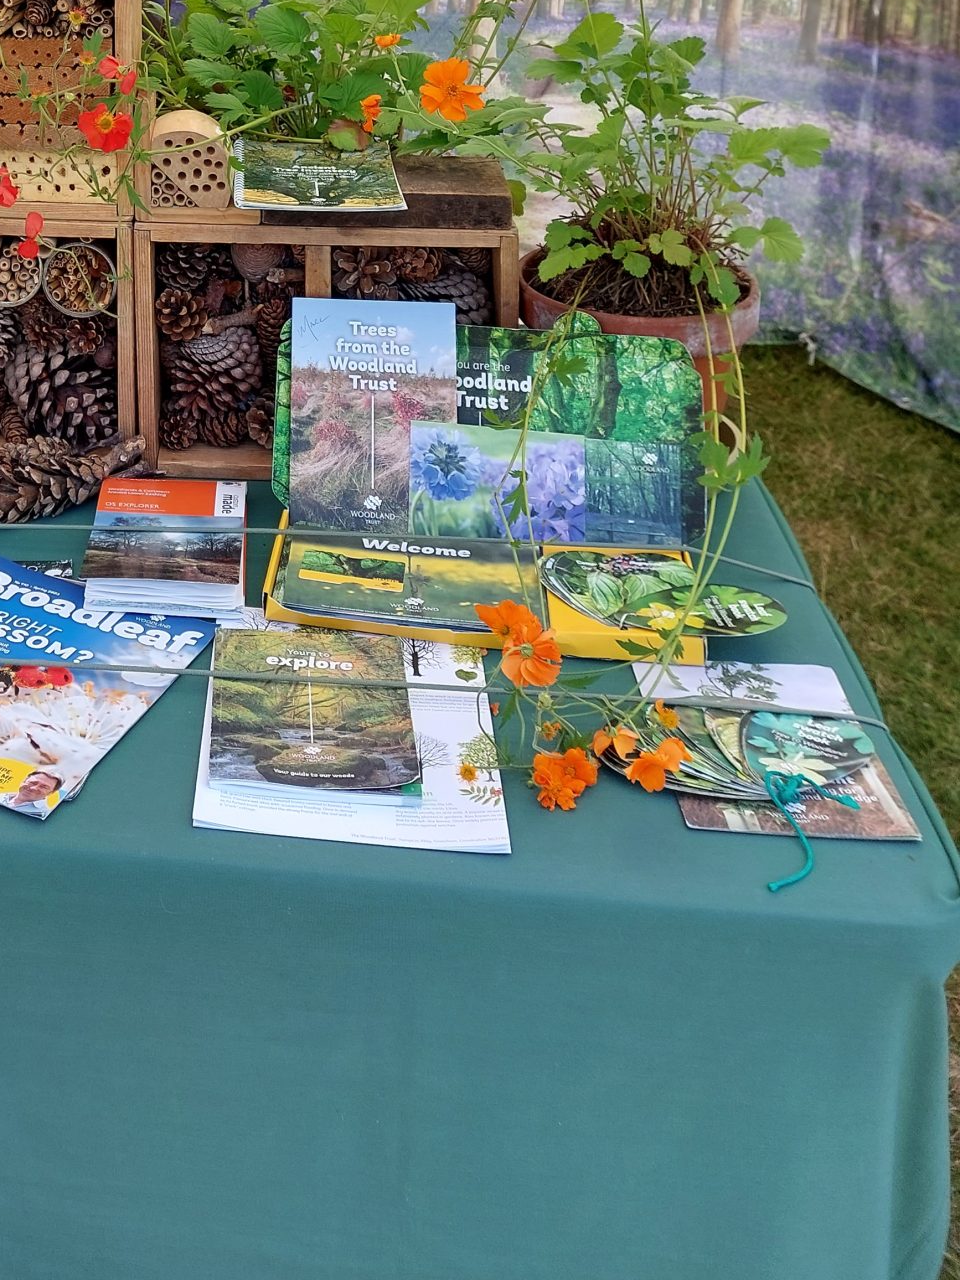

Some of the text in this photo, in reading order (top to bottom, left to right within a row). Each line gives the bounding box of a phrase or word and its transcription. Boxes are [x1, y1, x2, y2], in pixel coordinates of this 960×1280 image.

[348, 320, 397, 337] Trees
[336, 338, 410, 356] from the
[329, 355, 418, 375] Woodland
[456, 361, 511, 372] ou are the
[348, 374, 398, 392] Trust
[456, 372, 532, 393] oodland
[456, 390, 509, 411] Trust
[118, 502, 160, 510] EXPLORER
[221, 493, 234, 515] made
[350, 510, 396, 520] WOODLAND
[362, 537, 472, 559] Welcome
[286, 648, 330, 658] Yours to
[265, 655, 354, 671] explore
[793, 722, 844, 742] swatch
[806, 718, 840, 733] Leaf
[797, 729, 831, 746] book
[291, 752, 336, 761] WOODLAND
[0, 773, 14, 781] ME
